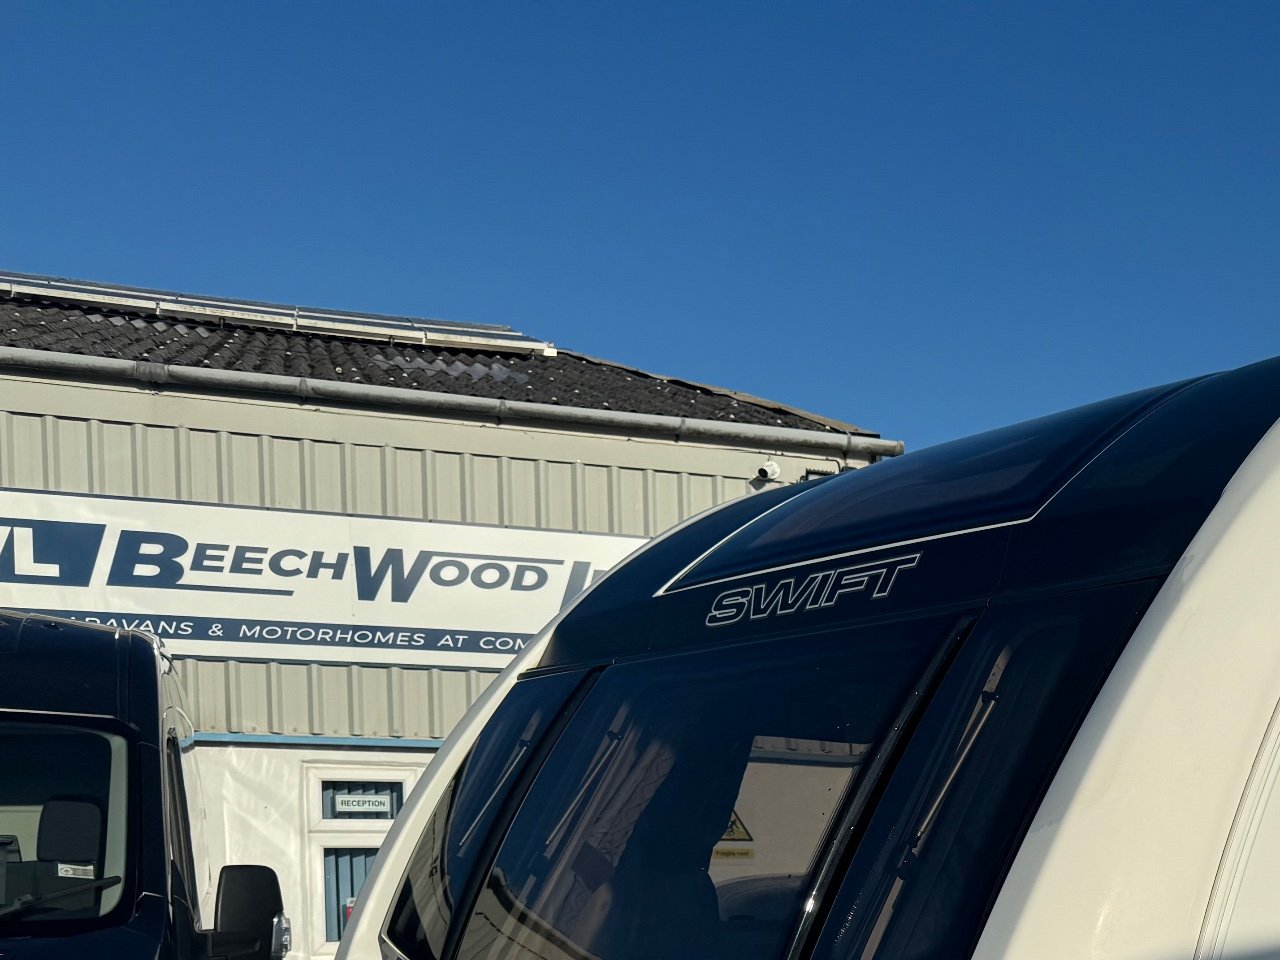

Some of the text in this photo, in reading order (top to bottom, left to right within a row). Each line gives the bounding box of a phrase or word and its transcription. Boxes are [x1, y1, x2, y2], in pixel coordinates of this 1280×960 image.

[705, 550, 923, 627] SWIFT
[208, 623, 224, 637] &
[239, 624, 425, 646] MOTORHOMES
[437, 634, 469, 647] AT
[340, 799, 386, 808] RECEPTION
